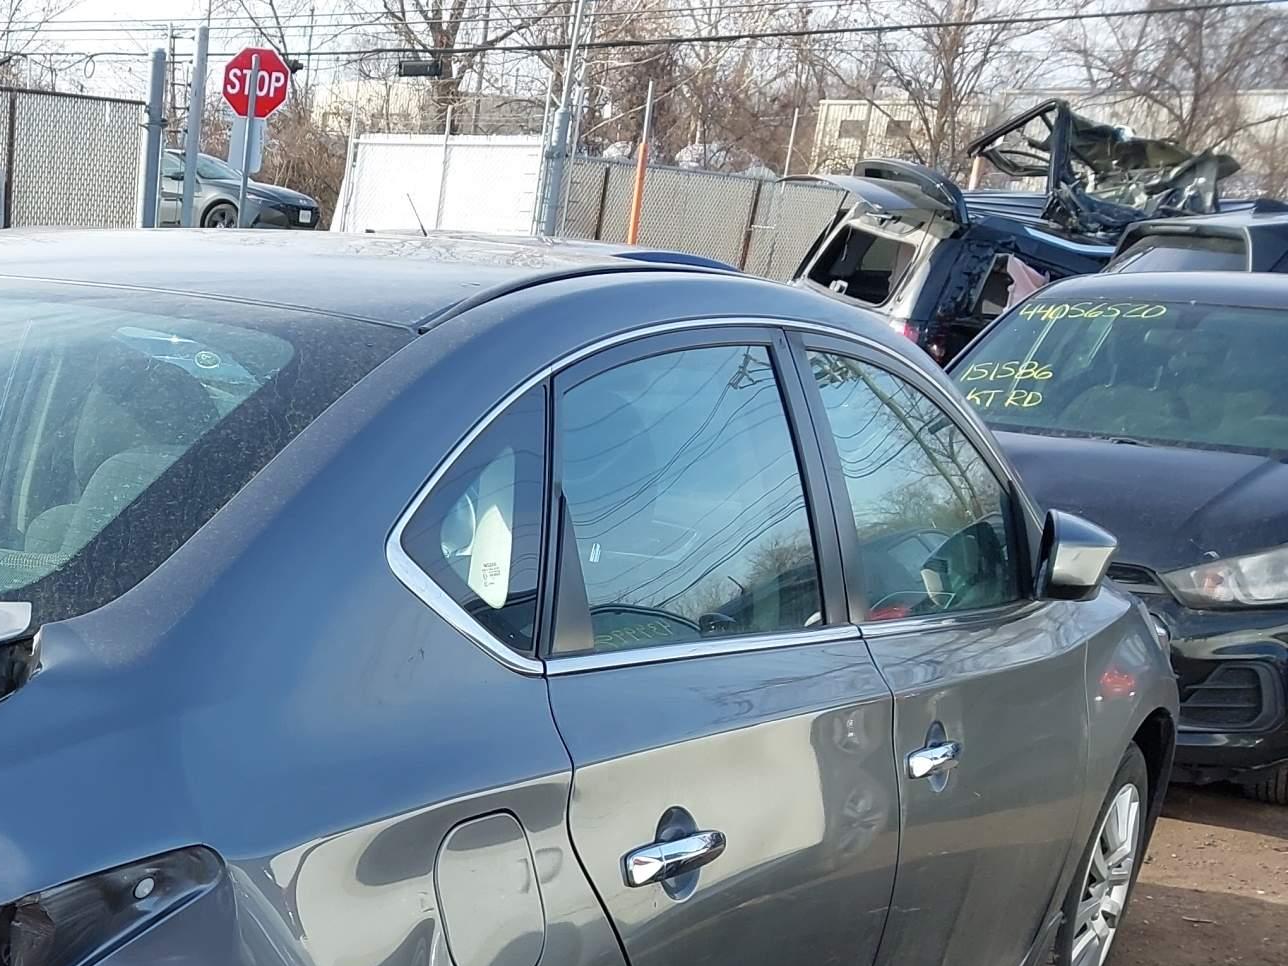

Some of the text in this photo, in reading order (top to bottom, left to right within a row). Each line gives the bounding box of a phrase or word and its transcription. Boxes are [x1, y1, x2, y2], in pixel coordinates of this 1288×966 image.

[226, 67, 285, 98] STOP
[1019, 301, 1167, 321] 44056520
[959, 360, 1053, 382] 151586
[966, 387, 1043, 408] KT RD
